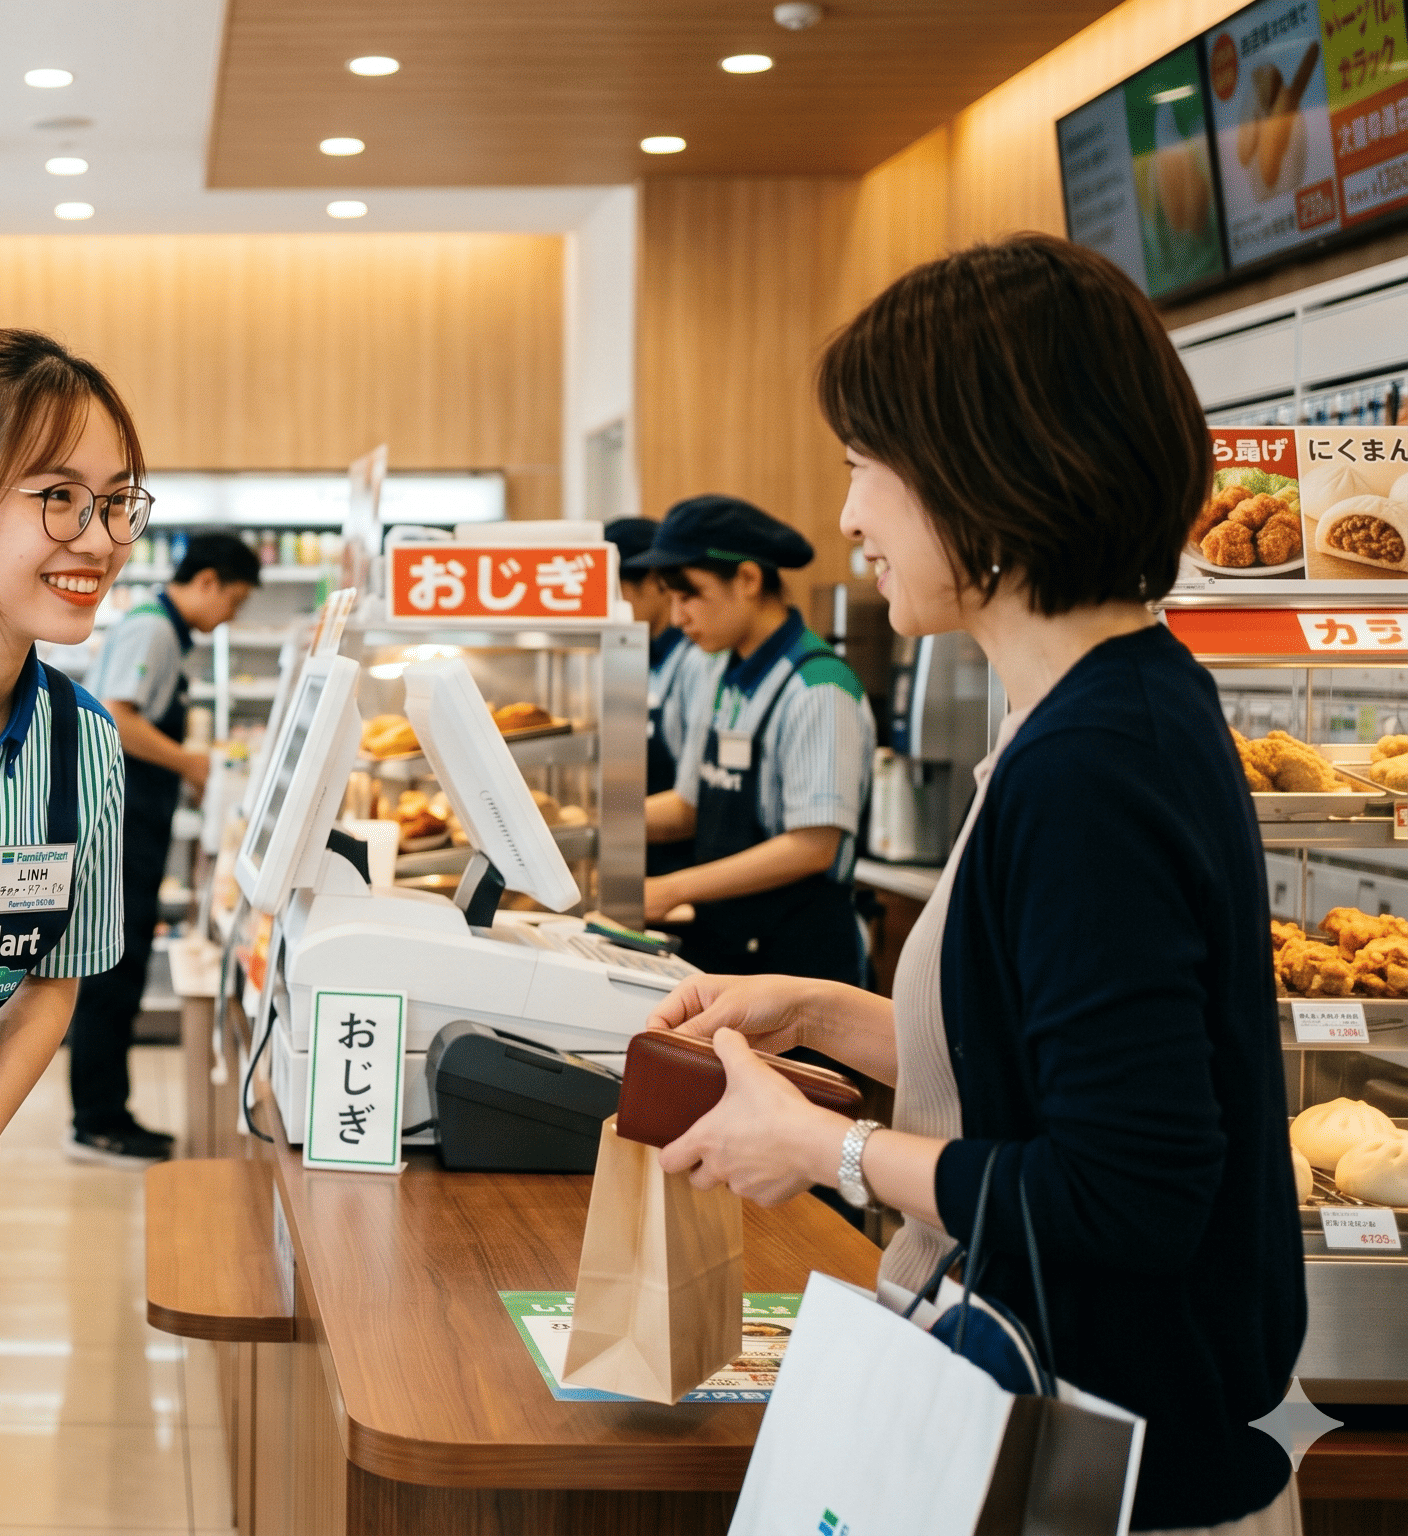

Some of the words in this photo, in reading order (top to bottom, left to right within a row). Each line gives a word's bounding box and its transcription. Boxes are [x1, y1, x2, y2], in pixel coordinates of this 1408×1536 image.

[408, 555, 595, 612] おじぎ
[18, 868, 49, 881] LINH
[337, 1011, 377, 1145] おじぎ
